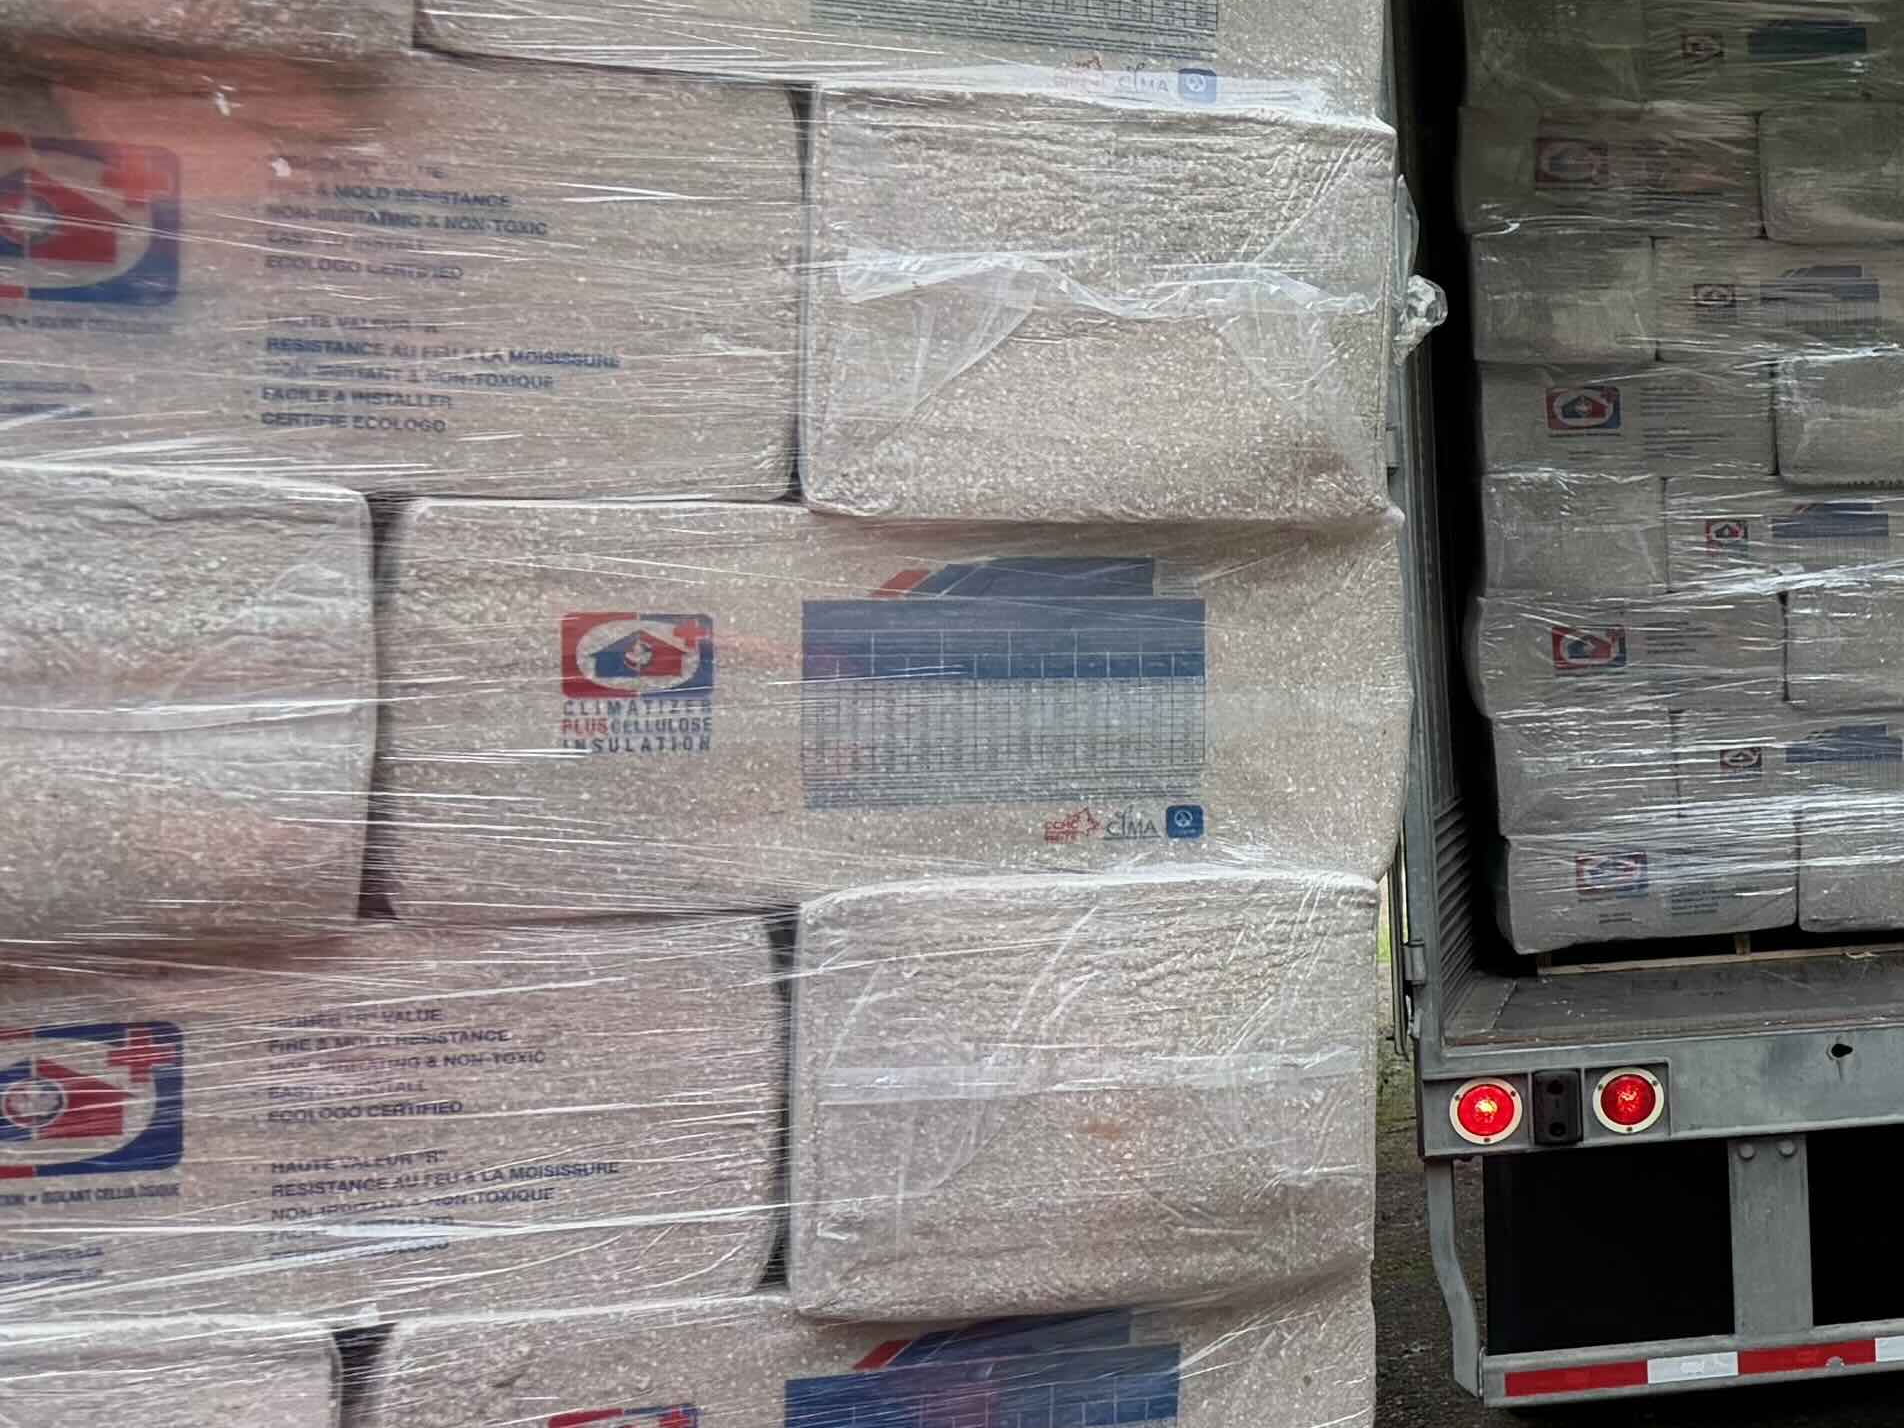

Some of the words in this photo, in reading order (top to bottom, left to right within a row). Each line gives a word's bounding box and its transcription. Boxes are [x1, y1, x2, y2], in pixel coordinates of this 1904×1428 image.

[562, 699, 713, 716] CLIMATIZER
[560, 718, 609, 735] PLUS
[610, 717, 713, 735] CELLULOSE
[562, 735, 711, 753] INSULATION
[1105, 807, 1160, 837] CIMA
[366, 1100, 464, 1119] CERTIFIED
[270, 1176, 387, 1197] RESISTANCE
[509, 1161, 620, 1181] MOISISSURE
